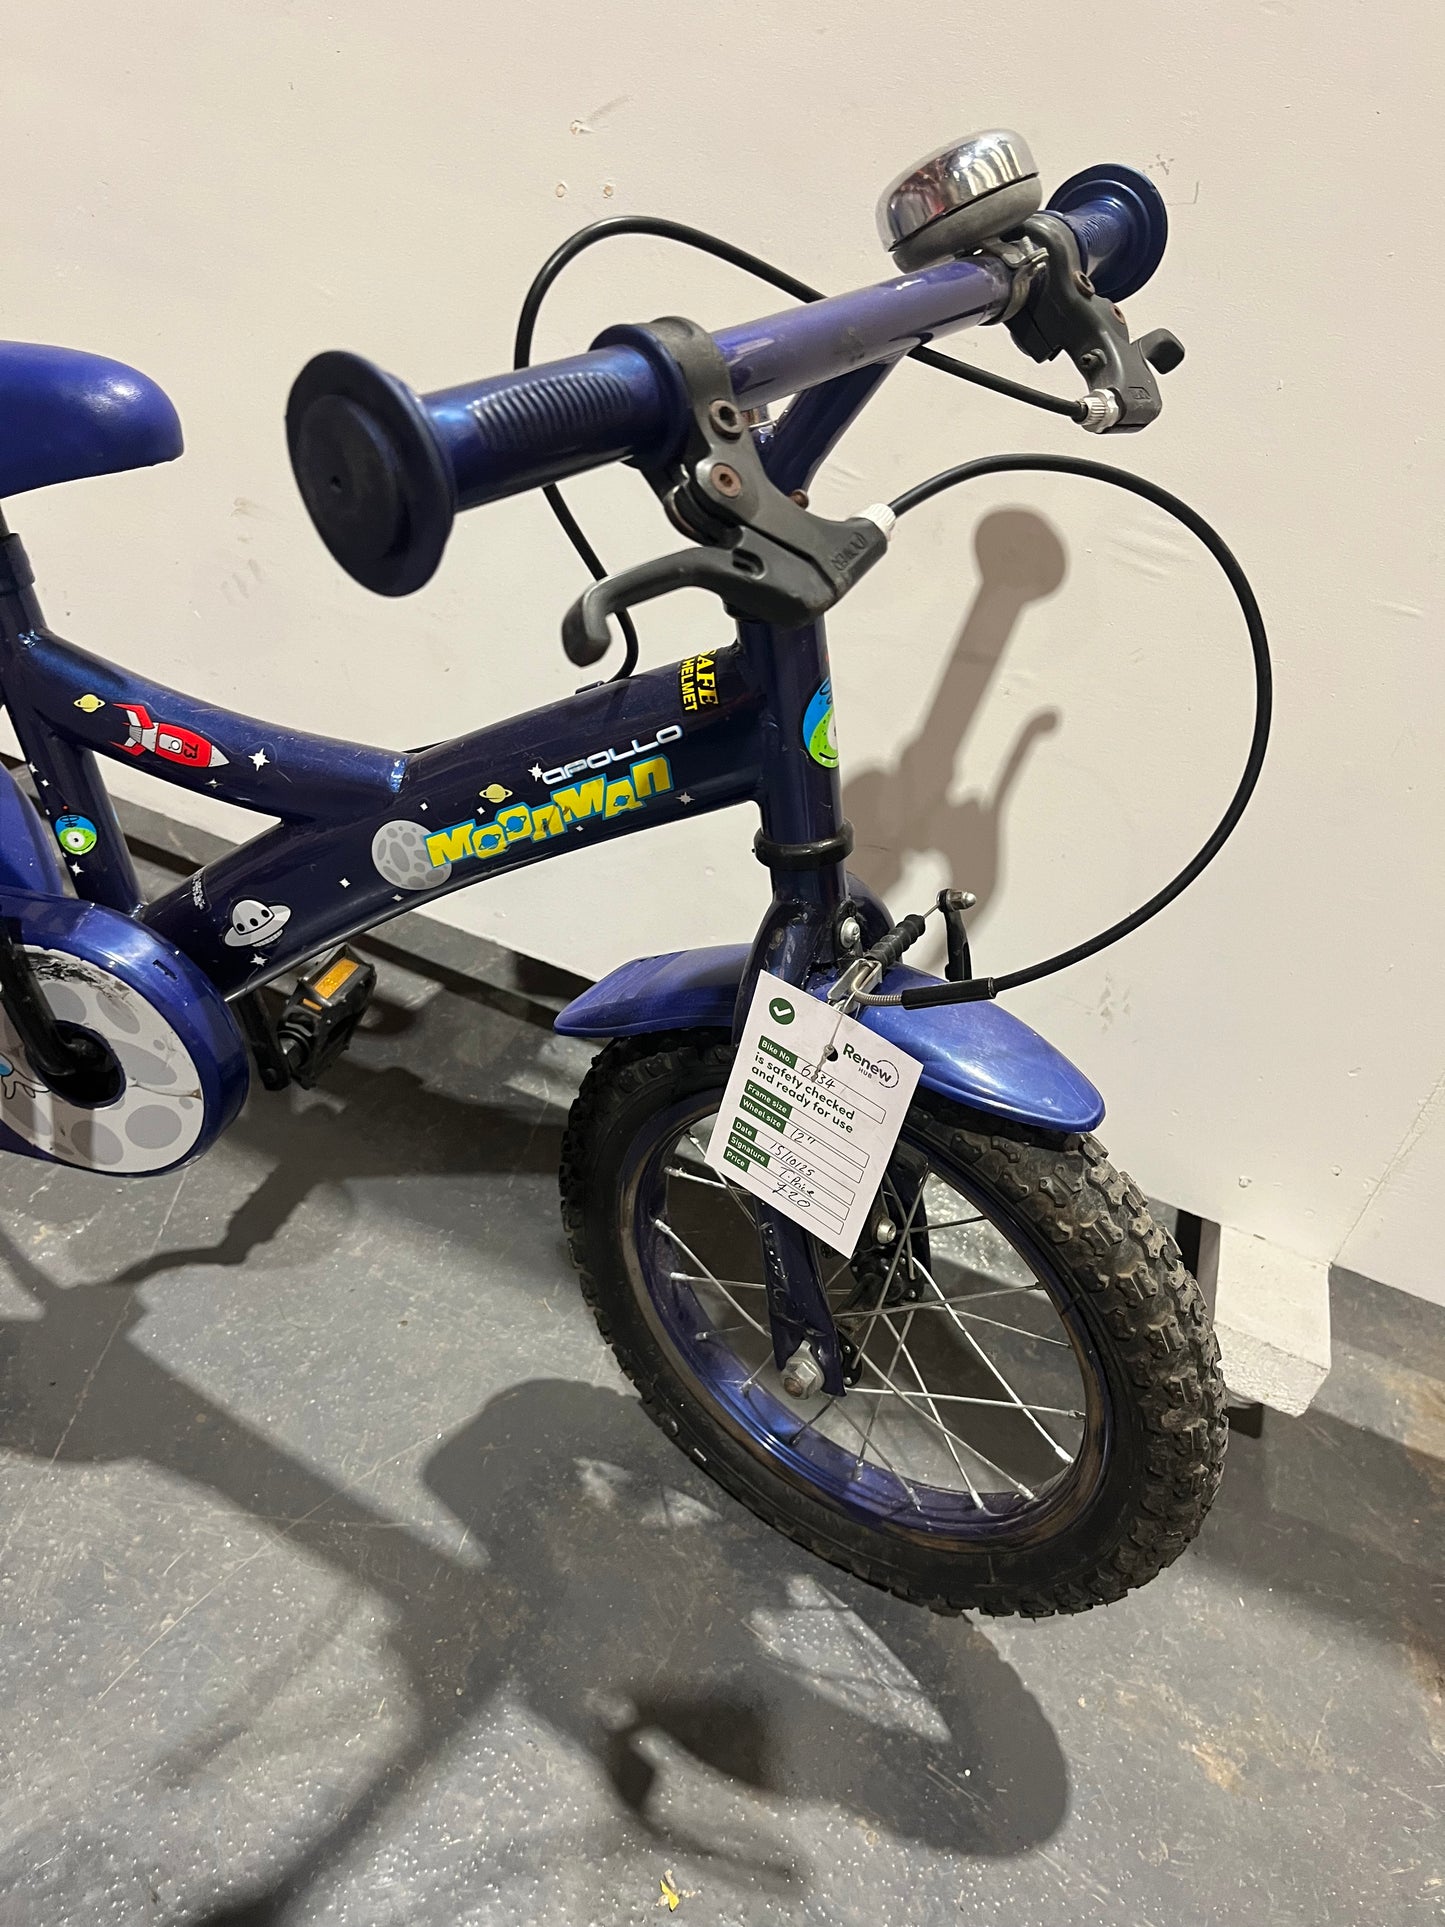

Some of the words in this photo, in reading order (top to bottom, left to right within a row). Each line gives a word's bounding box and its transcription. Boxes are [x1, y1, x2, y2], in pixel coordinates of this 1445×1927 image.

[681, 658, 698, 711] HELMET
[183, 742, 199, 759] 73
[761, 1039, 778, 1055] Bike
[779, 1051, 792, 1064] No.
[843, 1043, 892, 1082] Renew
[754, 1052, 765, 1065] is
[767, 1061, 803, 1089] safety
[805, 1085, 855, 1120] checked
[801, 1064, 836, 1089] 634
[858, 1067, 873, 1079] HUB
[747, 1084, 771, 1103] Frame
[771, 1100, 788, 1114] size
[752, 1065, 775, 1084] and
[776, 1080, 811, 1108] ready
[812, 1101, 831, 1118] for
[832, 1115, 854, 1134] use
[742, 1098, 766, 1119] Wheel
[766, 1113, 781, 1128] size
[735, 1121, 753, 1137] Date
[726, 1150, 746, 1167] Price
[730, 1136, 766, 1162] Signature
[772, 1182, 811, 1208] £20
